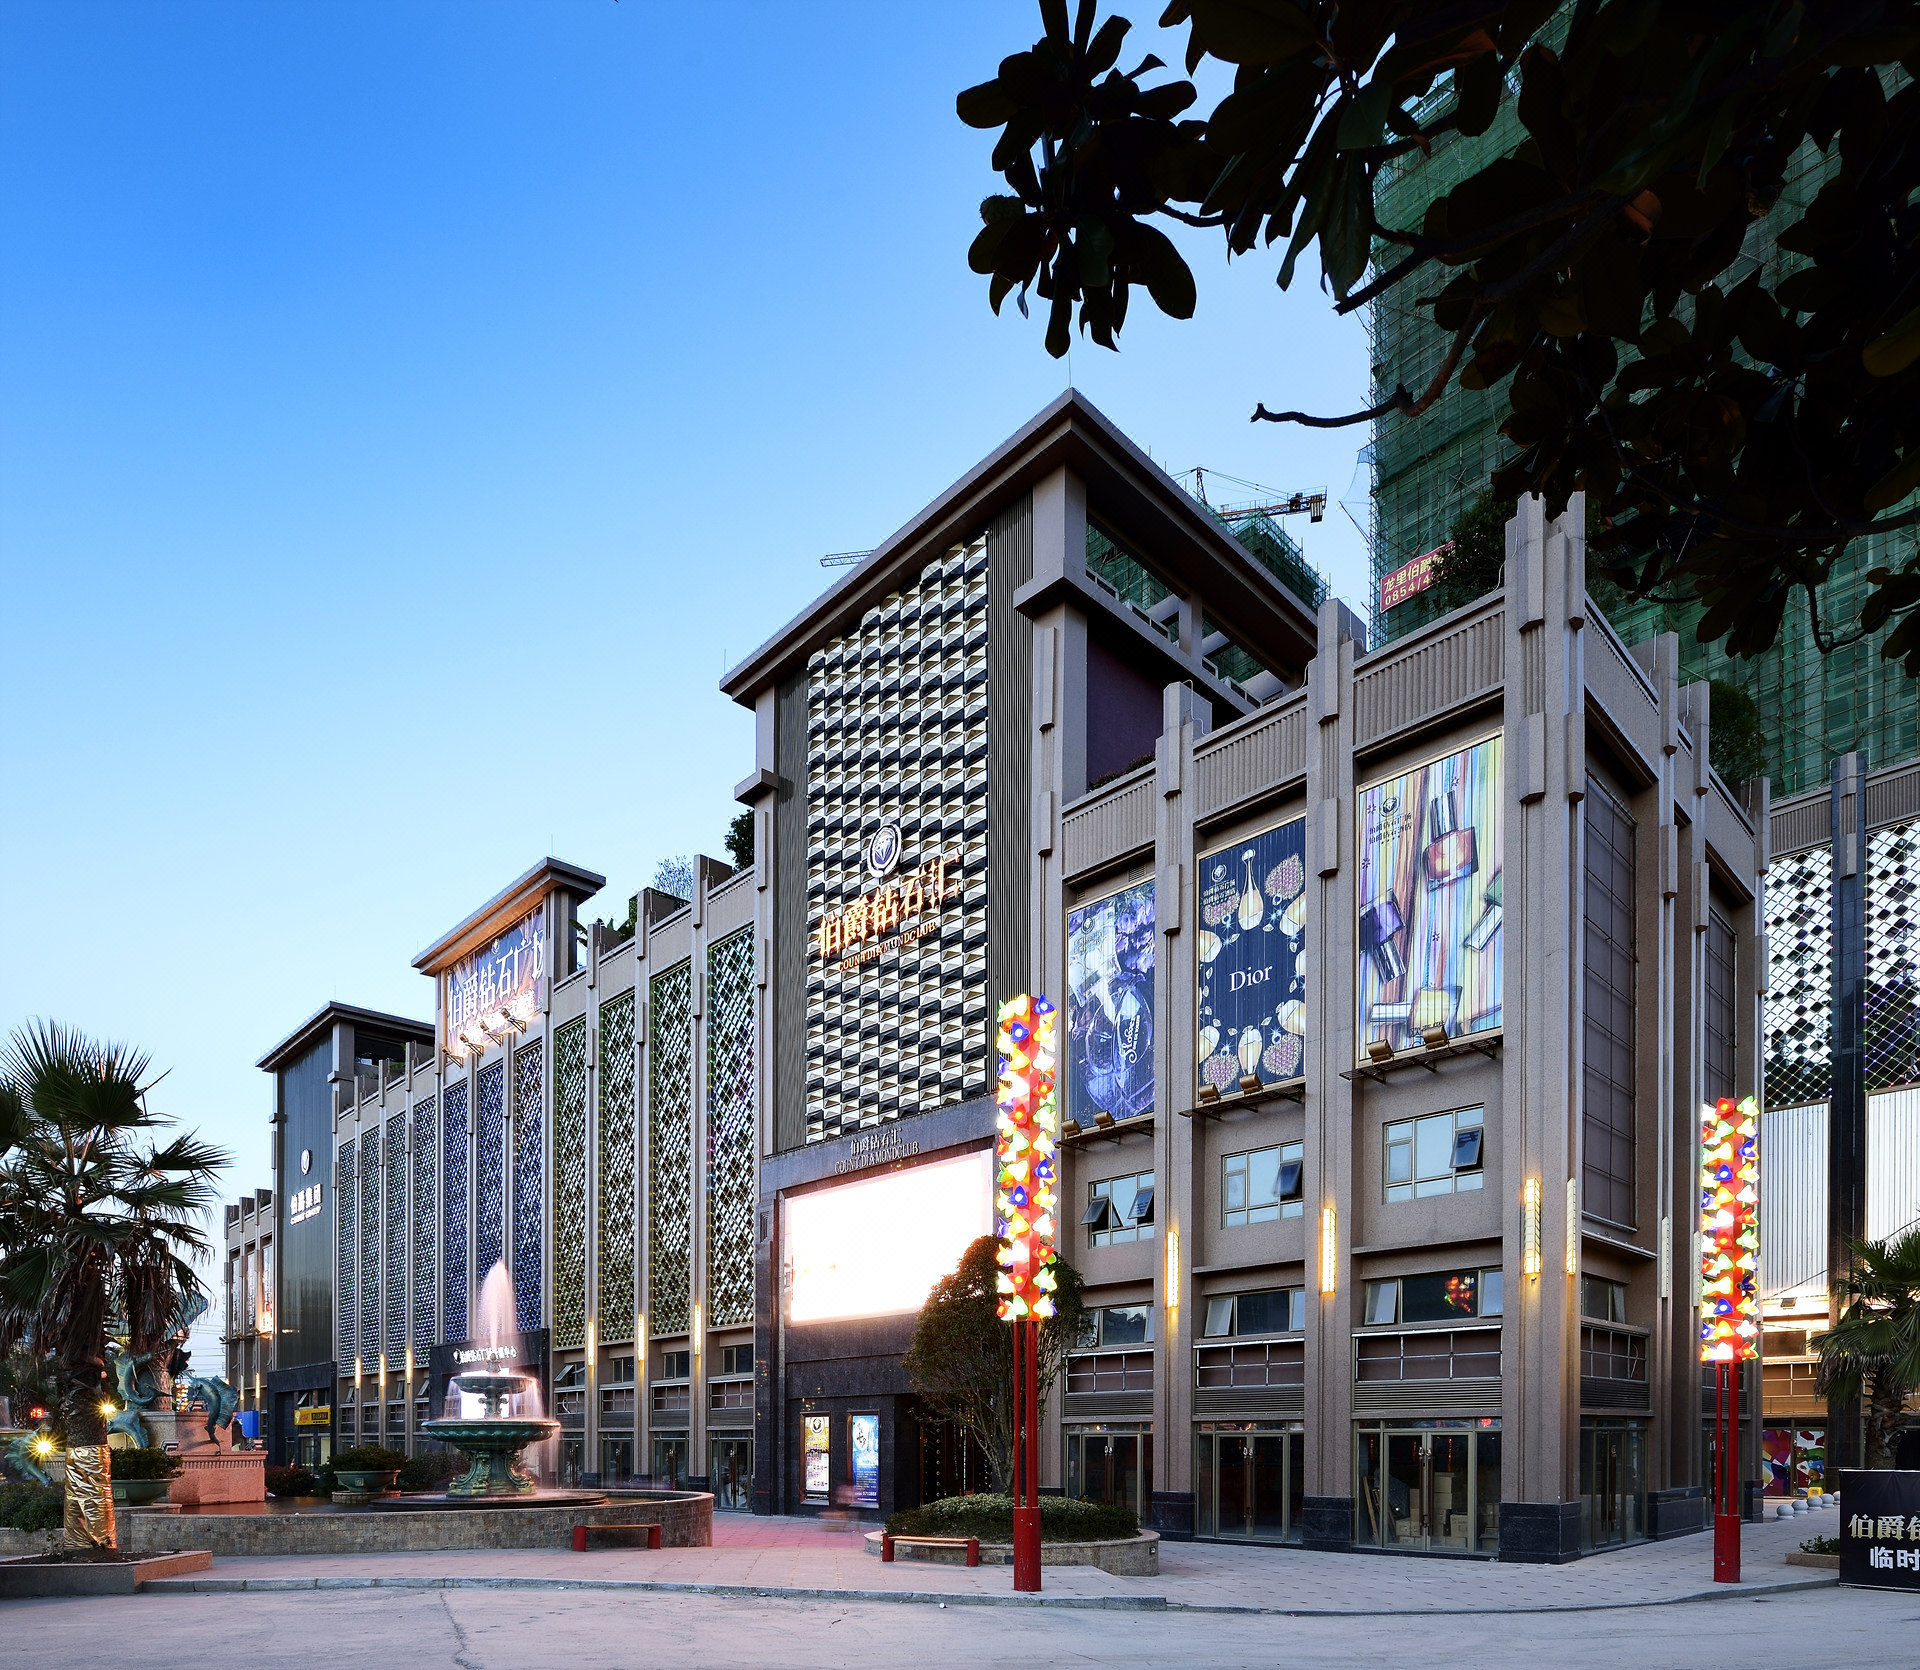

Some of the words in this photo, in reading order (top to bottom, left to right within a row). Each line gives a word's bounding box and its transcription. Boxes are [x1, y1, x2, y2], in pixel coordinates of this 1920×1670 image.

[1385, 573, 1432, 605] 0854/4
[816, 848, 961, 959] 伯爵钻石汇
[1229, 965, 1273, 992] Dior
[1870, 1546, 1920, 1571] 临时
